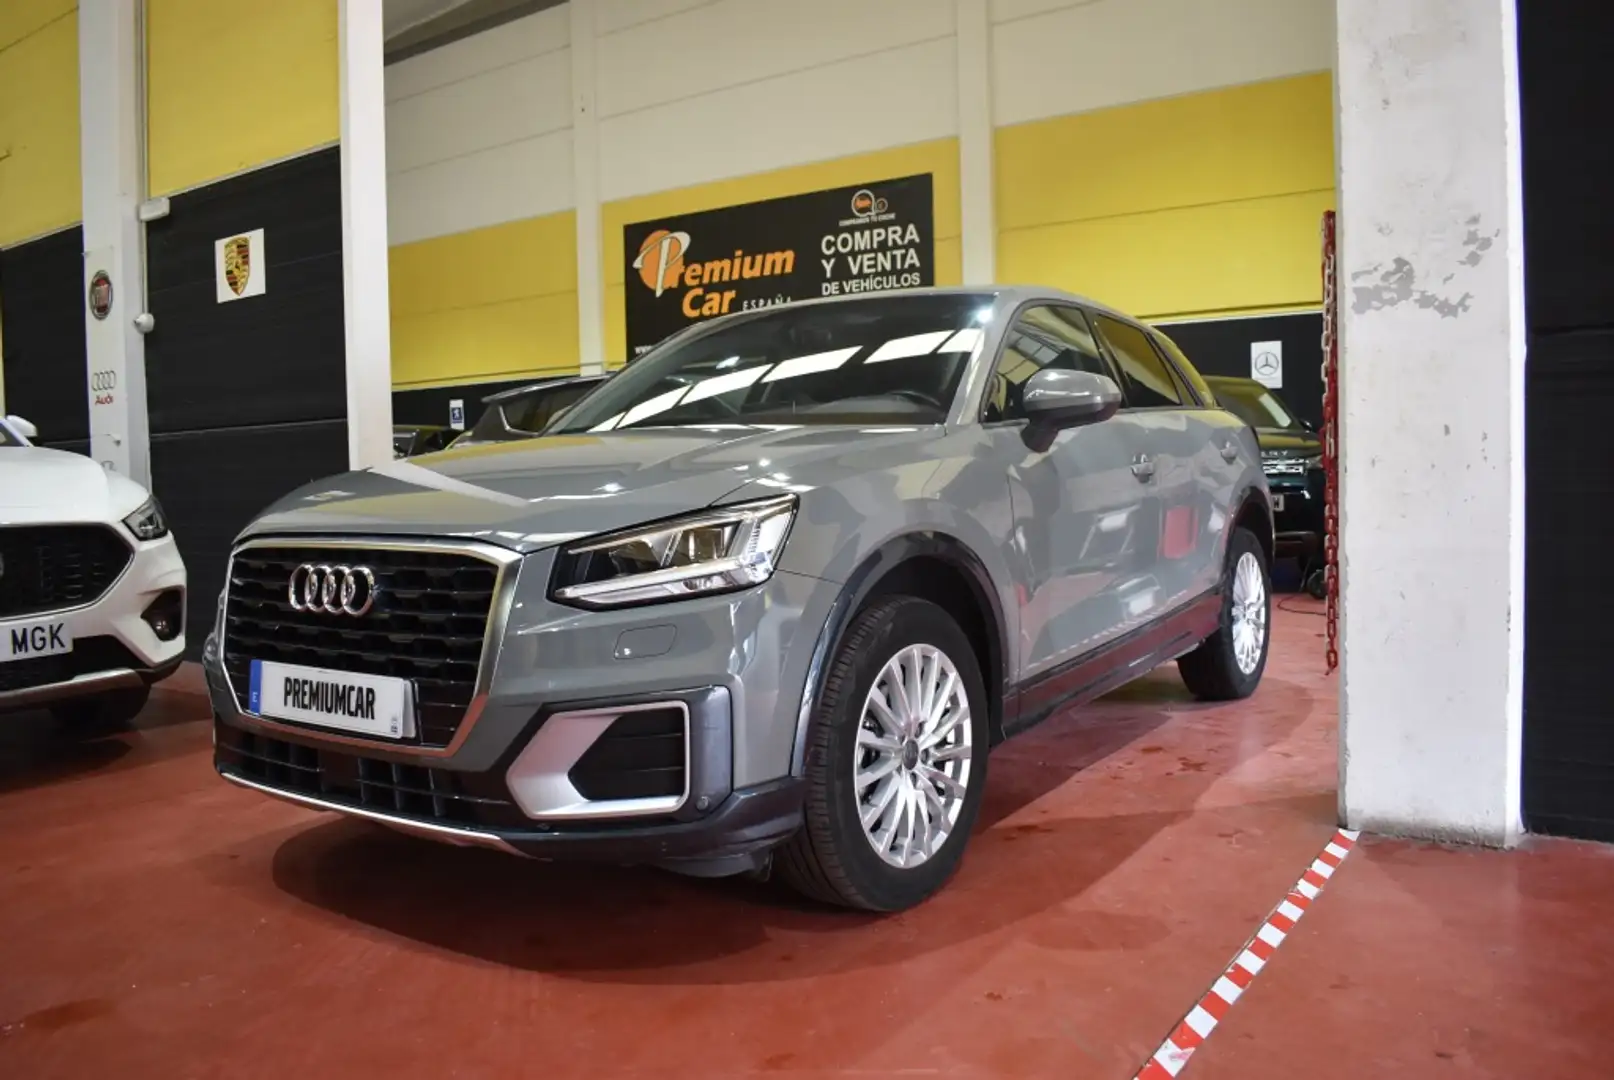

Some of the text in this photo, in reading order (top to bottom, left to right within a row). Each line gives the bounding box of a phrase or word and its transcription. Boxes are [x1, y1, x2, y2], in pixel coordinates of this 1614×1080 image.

[821, 223, 920, 256] COMPRA
[632, 230, 795, 298] Premium
[821, 247, 920, 279] Y VENTA
[821, 272, 920, 296] DE VEHÍCULOS
[682, 287, 737, 318] Car
[11, 622, 65, 655] MGK
[284, 676, 376, 719] PREMIUMCAR
